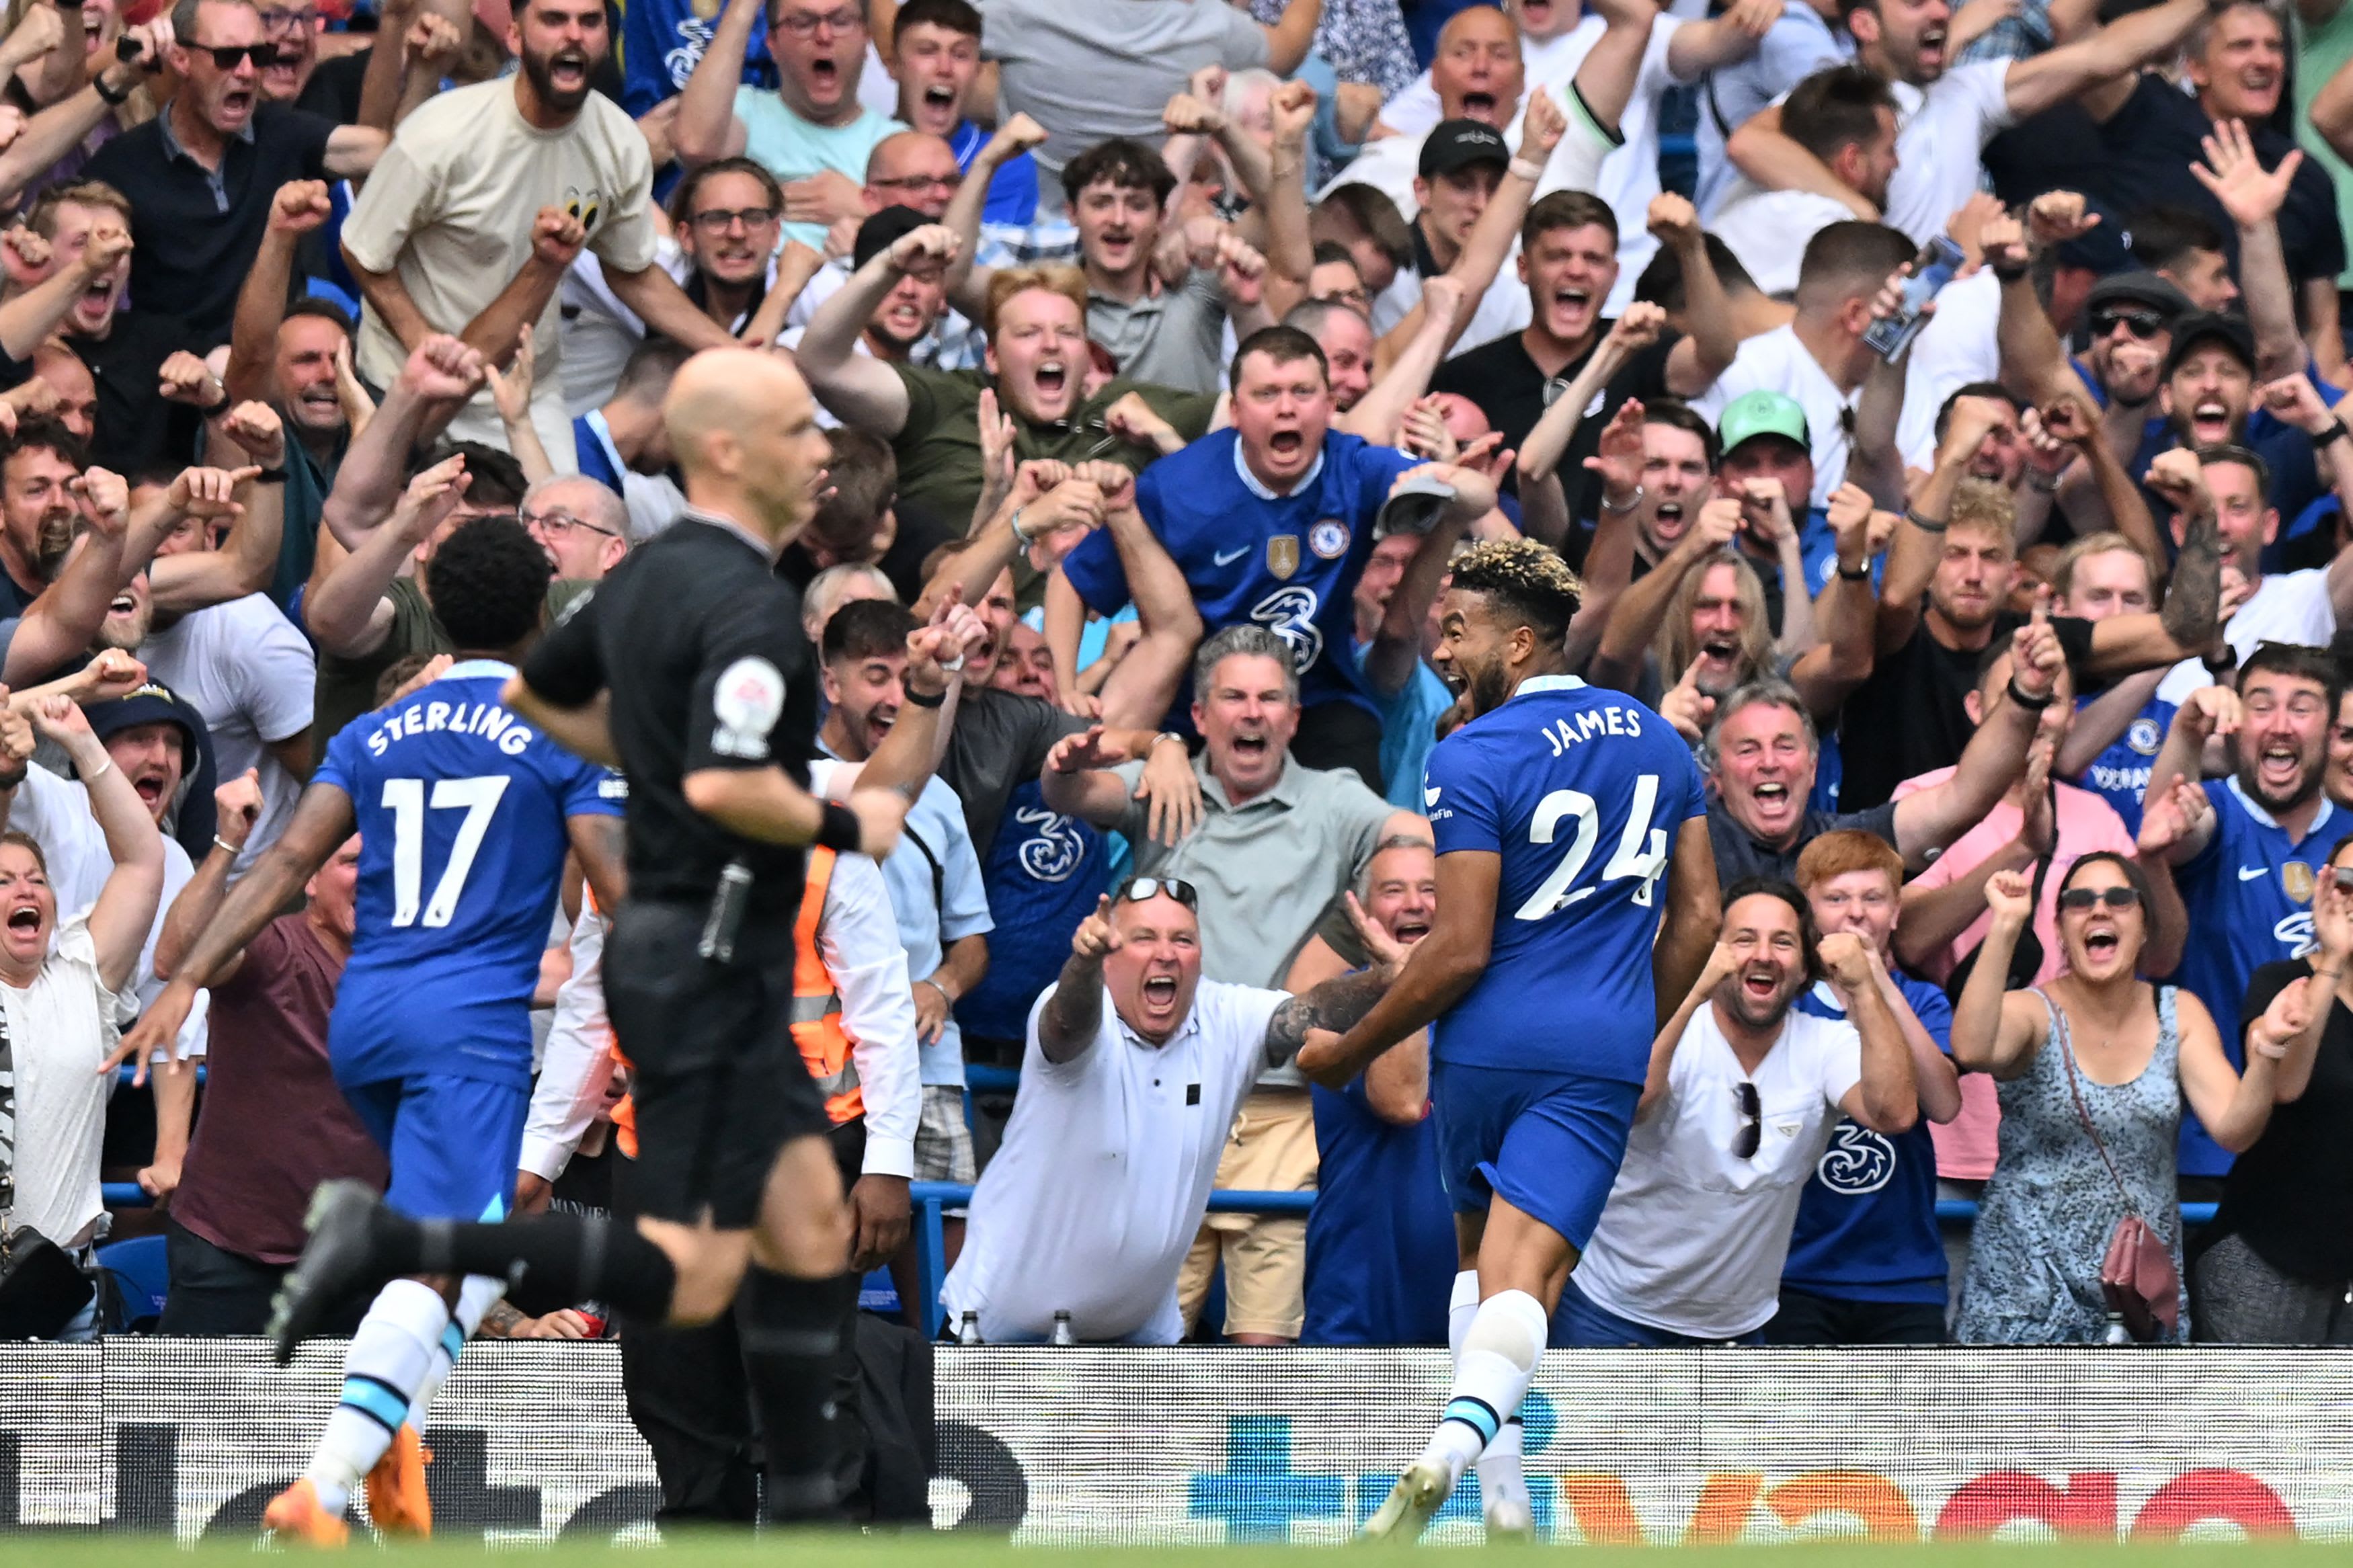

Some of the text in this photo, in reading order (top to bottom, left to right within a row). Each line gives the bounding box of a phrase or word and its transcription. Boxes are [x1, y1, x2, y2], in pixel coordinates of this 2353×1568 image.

[368, 701, 533, 757] STERLING
[1541, 706, 1642, 757] JAMES
[381, 775, 511, 927] 17
[1514, 774, 1669, 921] 24
[1188, 1389, 2297, 1544] tvago
